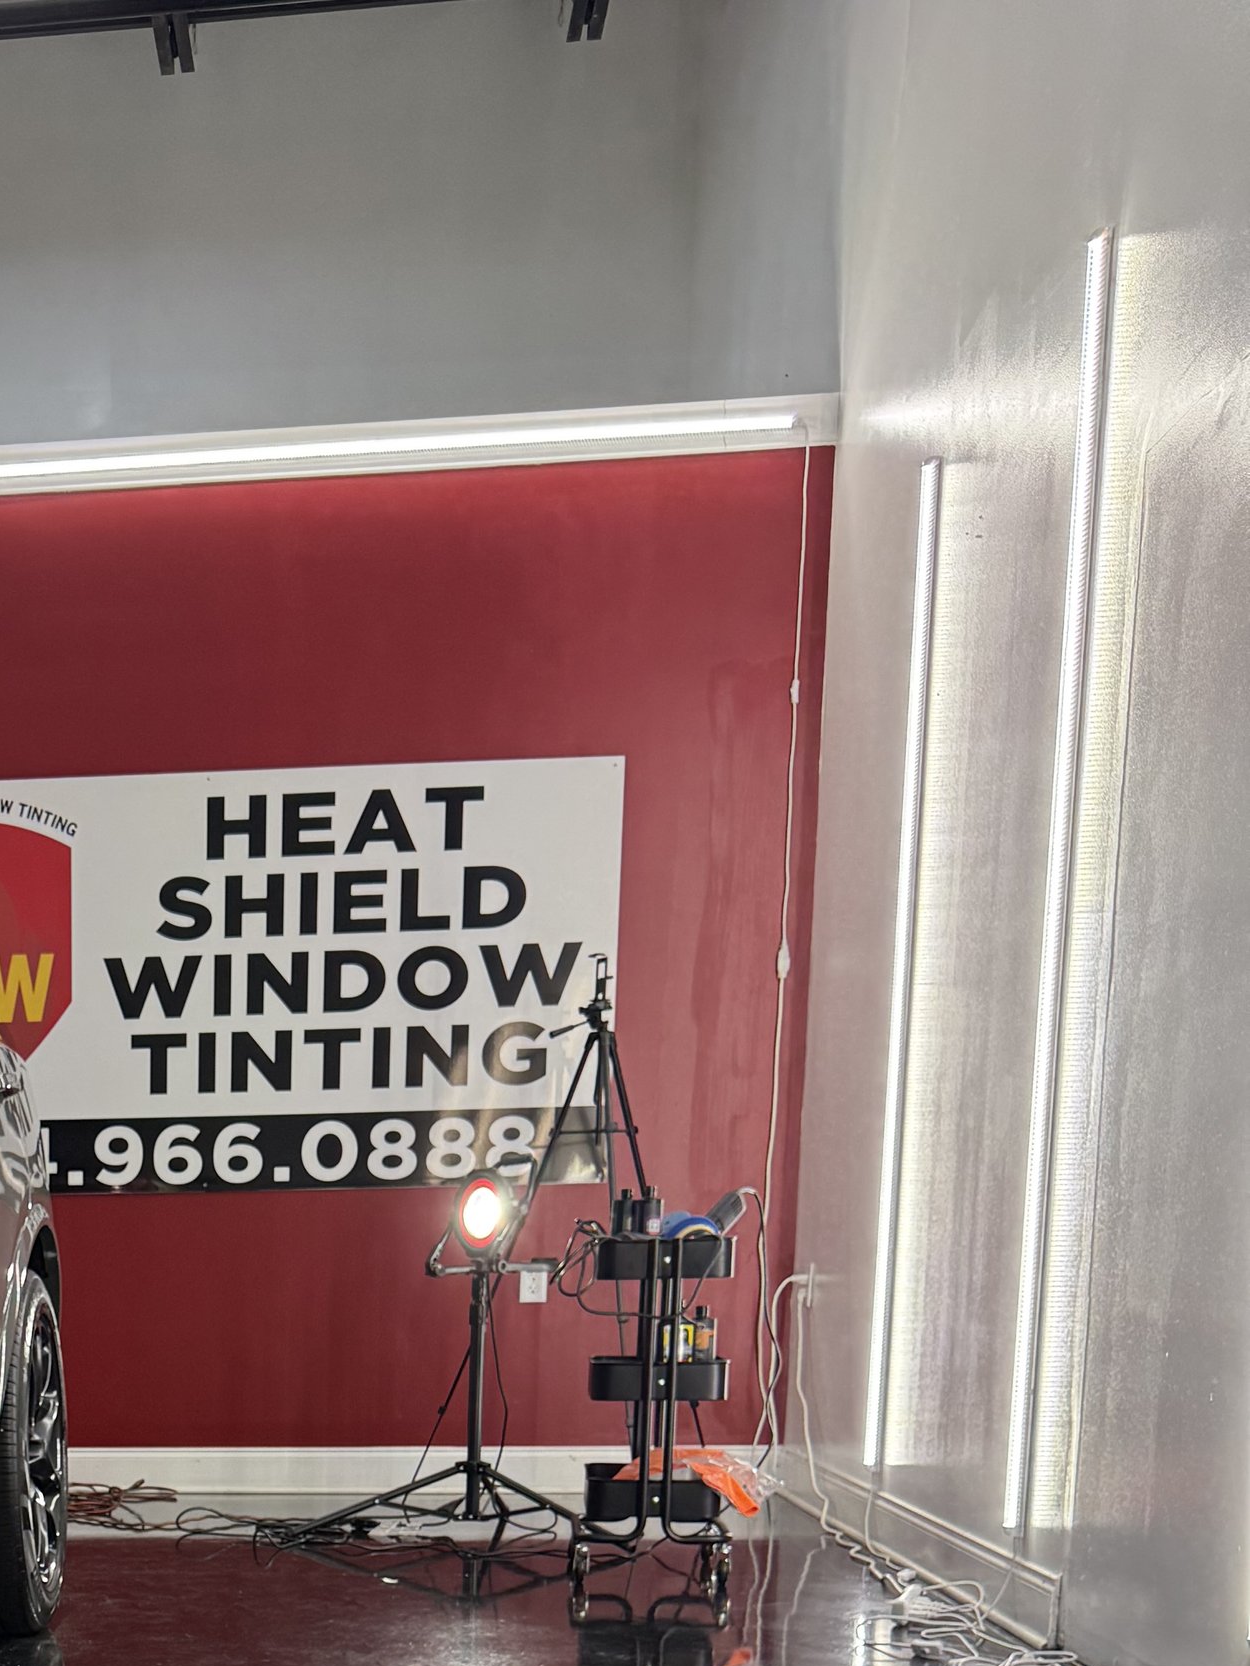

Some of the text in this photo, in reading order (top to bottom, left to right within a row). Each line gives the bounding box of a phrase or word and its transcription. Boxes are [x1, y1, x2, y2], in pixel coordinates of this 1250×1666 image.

[18, 802, 78, 838] TINTING
[206, 786, 485, 860] HEAT
[156, 866, 527, 941] SHIELD
[104, 941, 583, 1020] WINDOW
[130, 1021, 548, 1096] TINTING
